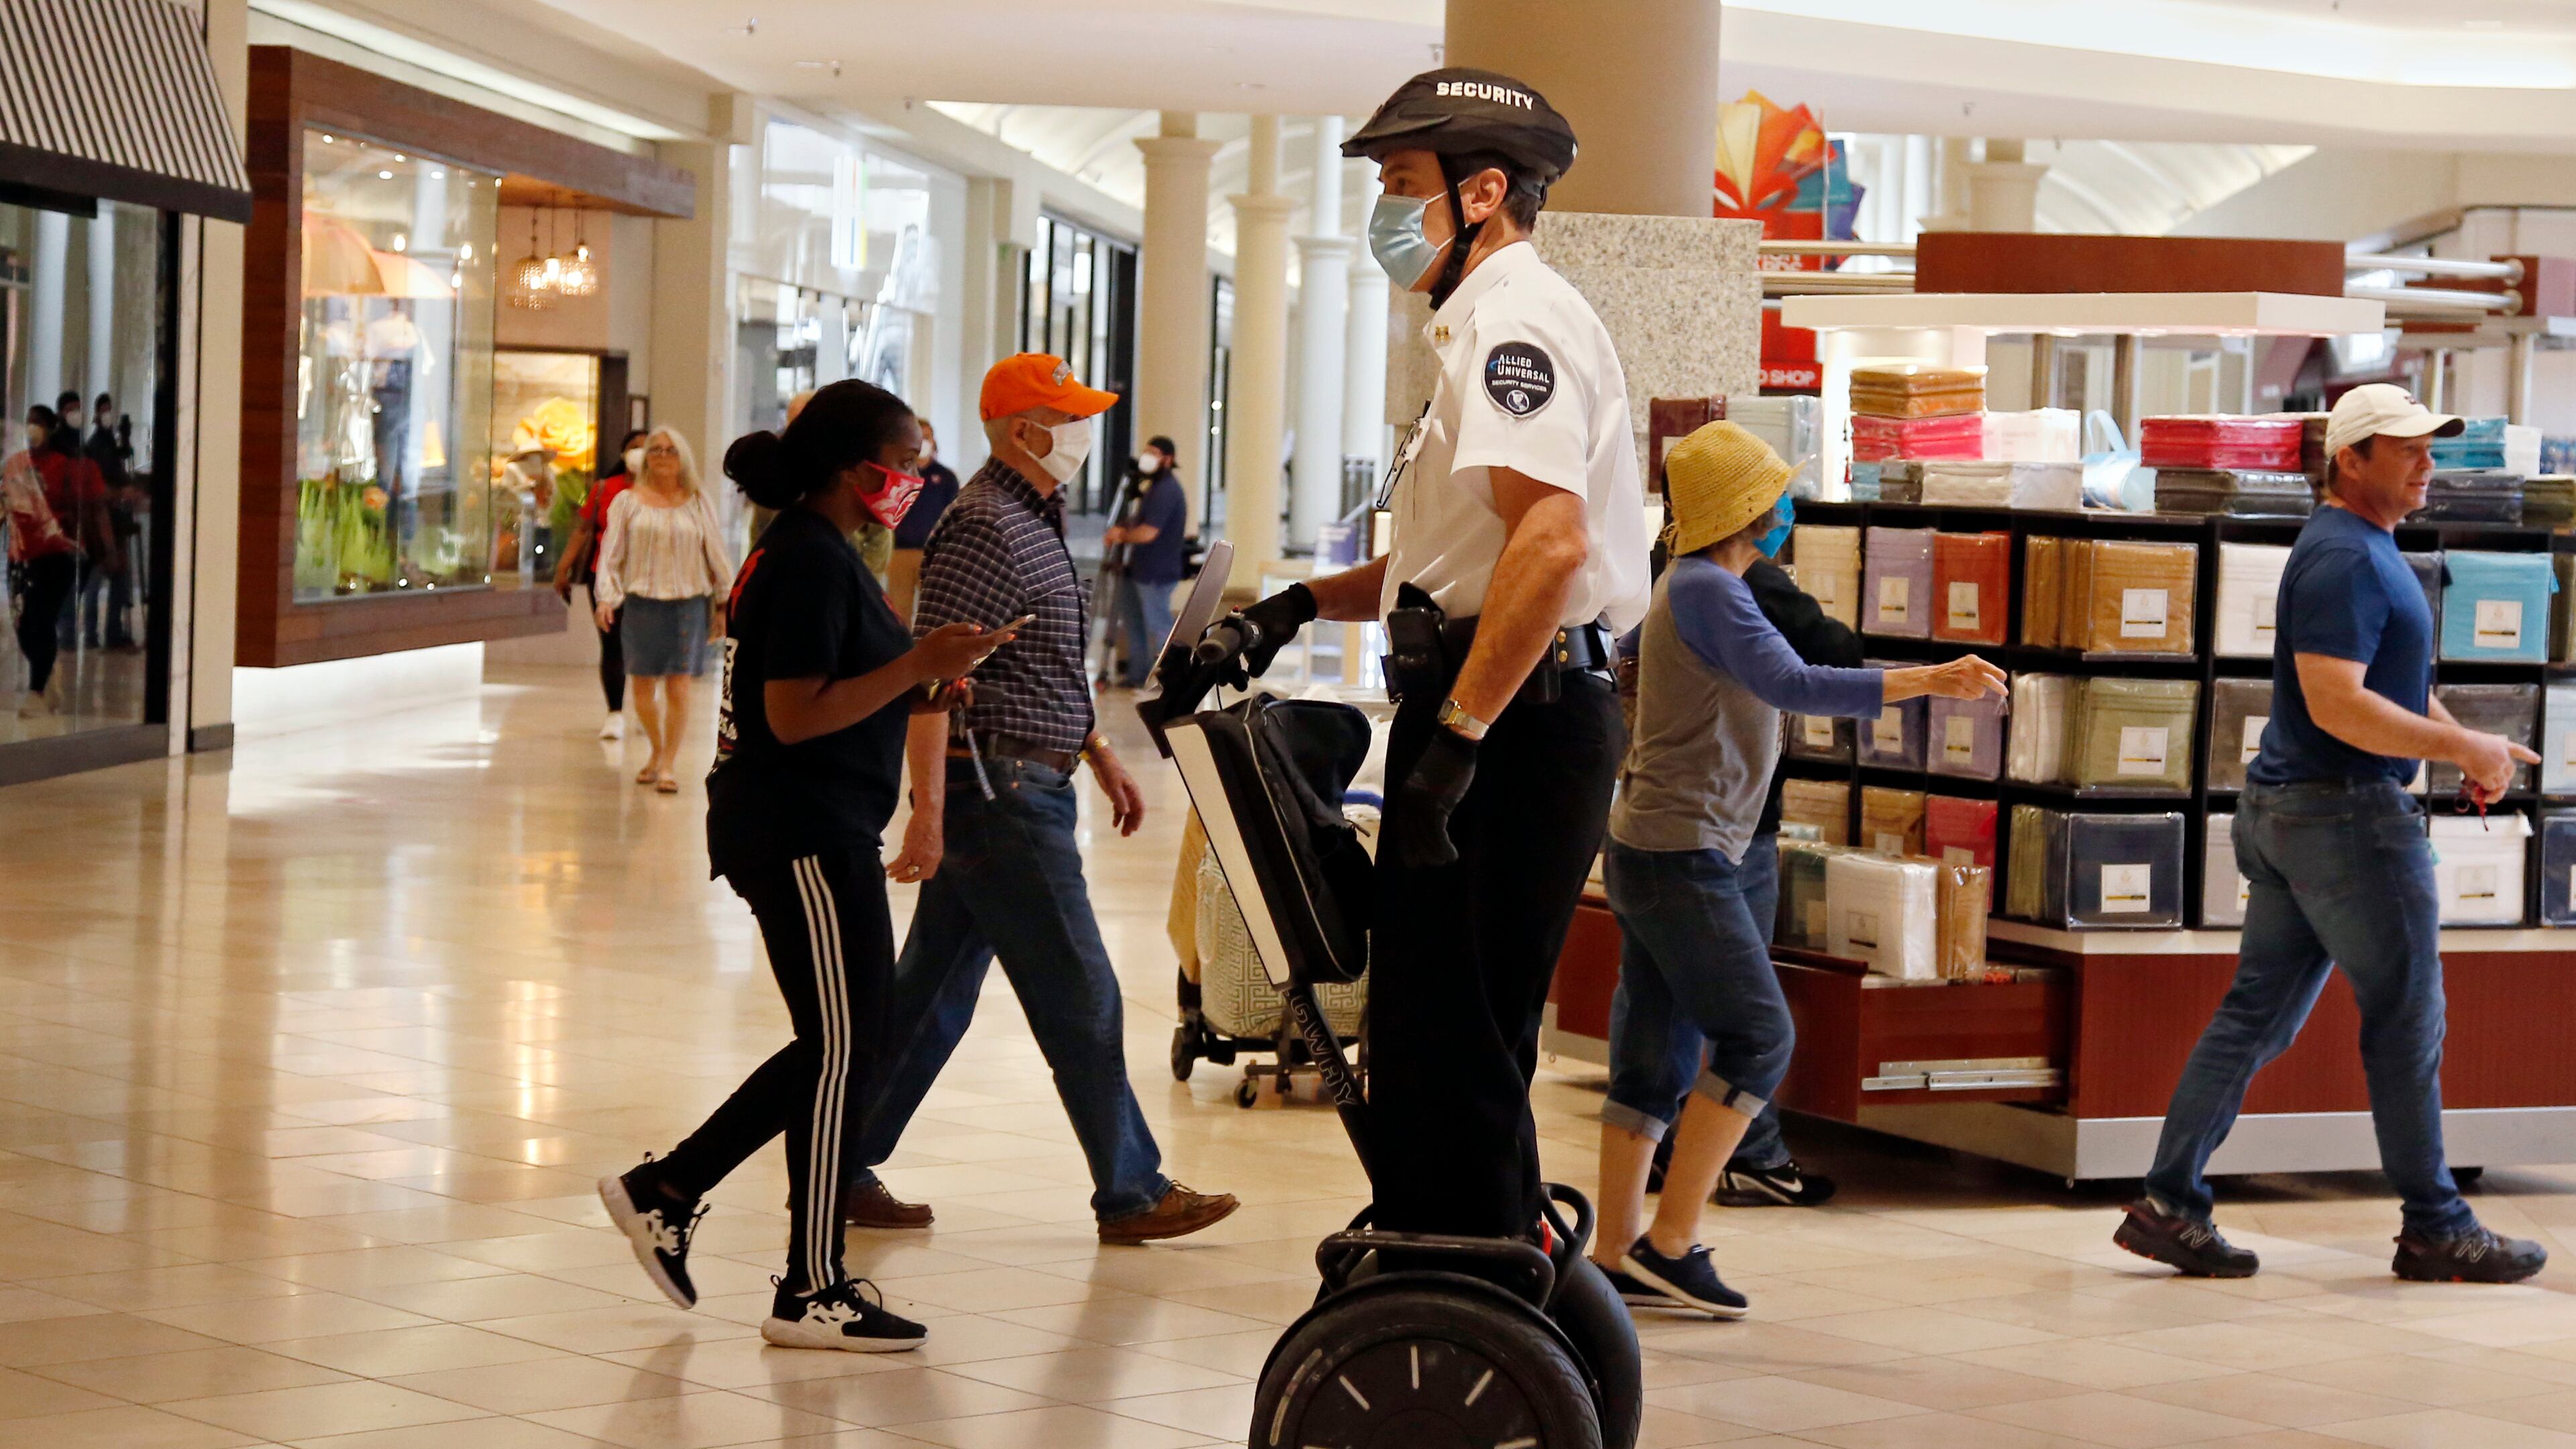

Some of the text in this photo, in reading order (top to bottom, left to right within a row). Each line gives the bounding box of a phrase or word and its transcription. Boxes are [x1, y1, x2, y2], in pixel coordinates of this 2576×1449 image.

[1436, 82, 1534, 110] SECURITY
[1498, 354, 1532, 368] ALLIED
[1497, 365, 1550, 384] UNIVERSAL
[1770, 369, 1816, 387] SHOP
[1520, 382, 1547, 392] SERVICES
[1282, 989, 1358, 1106] GWAY
